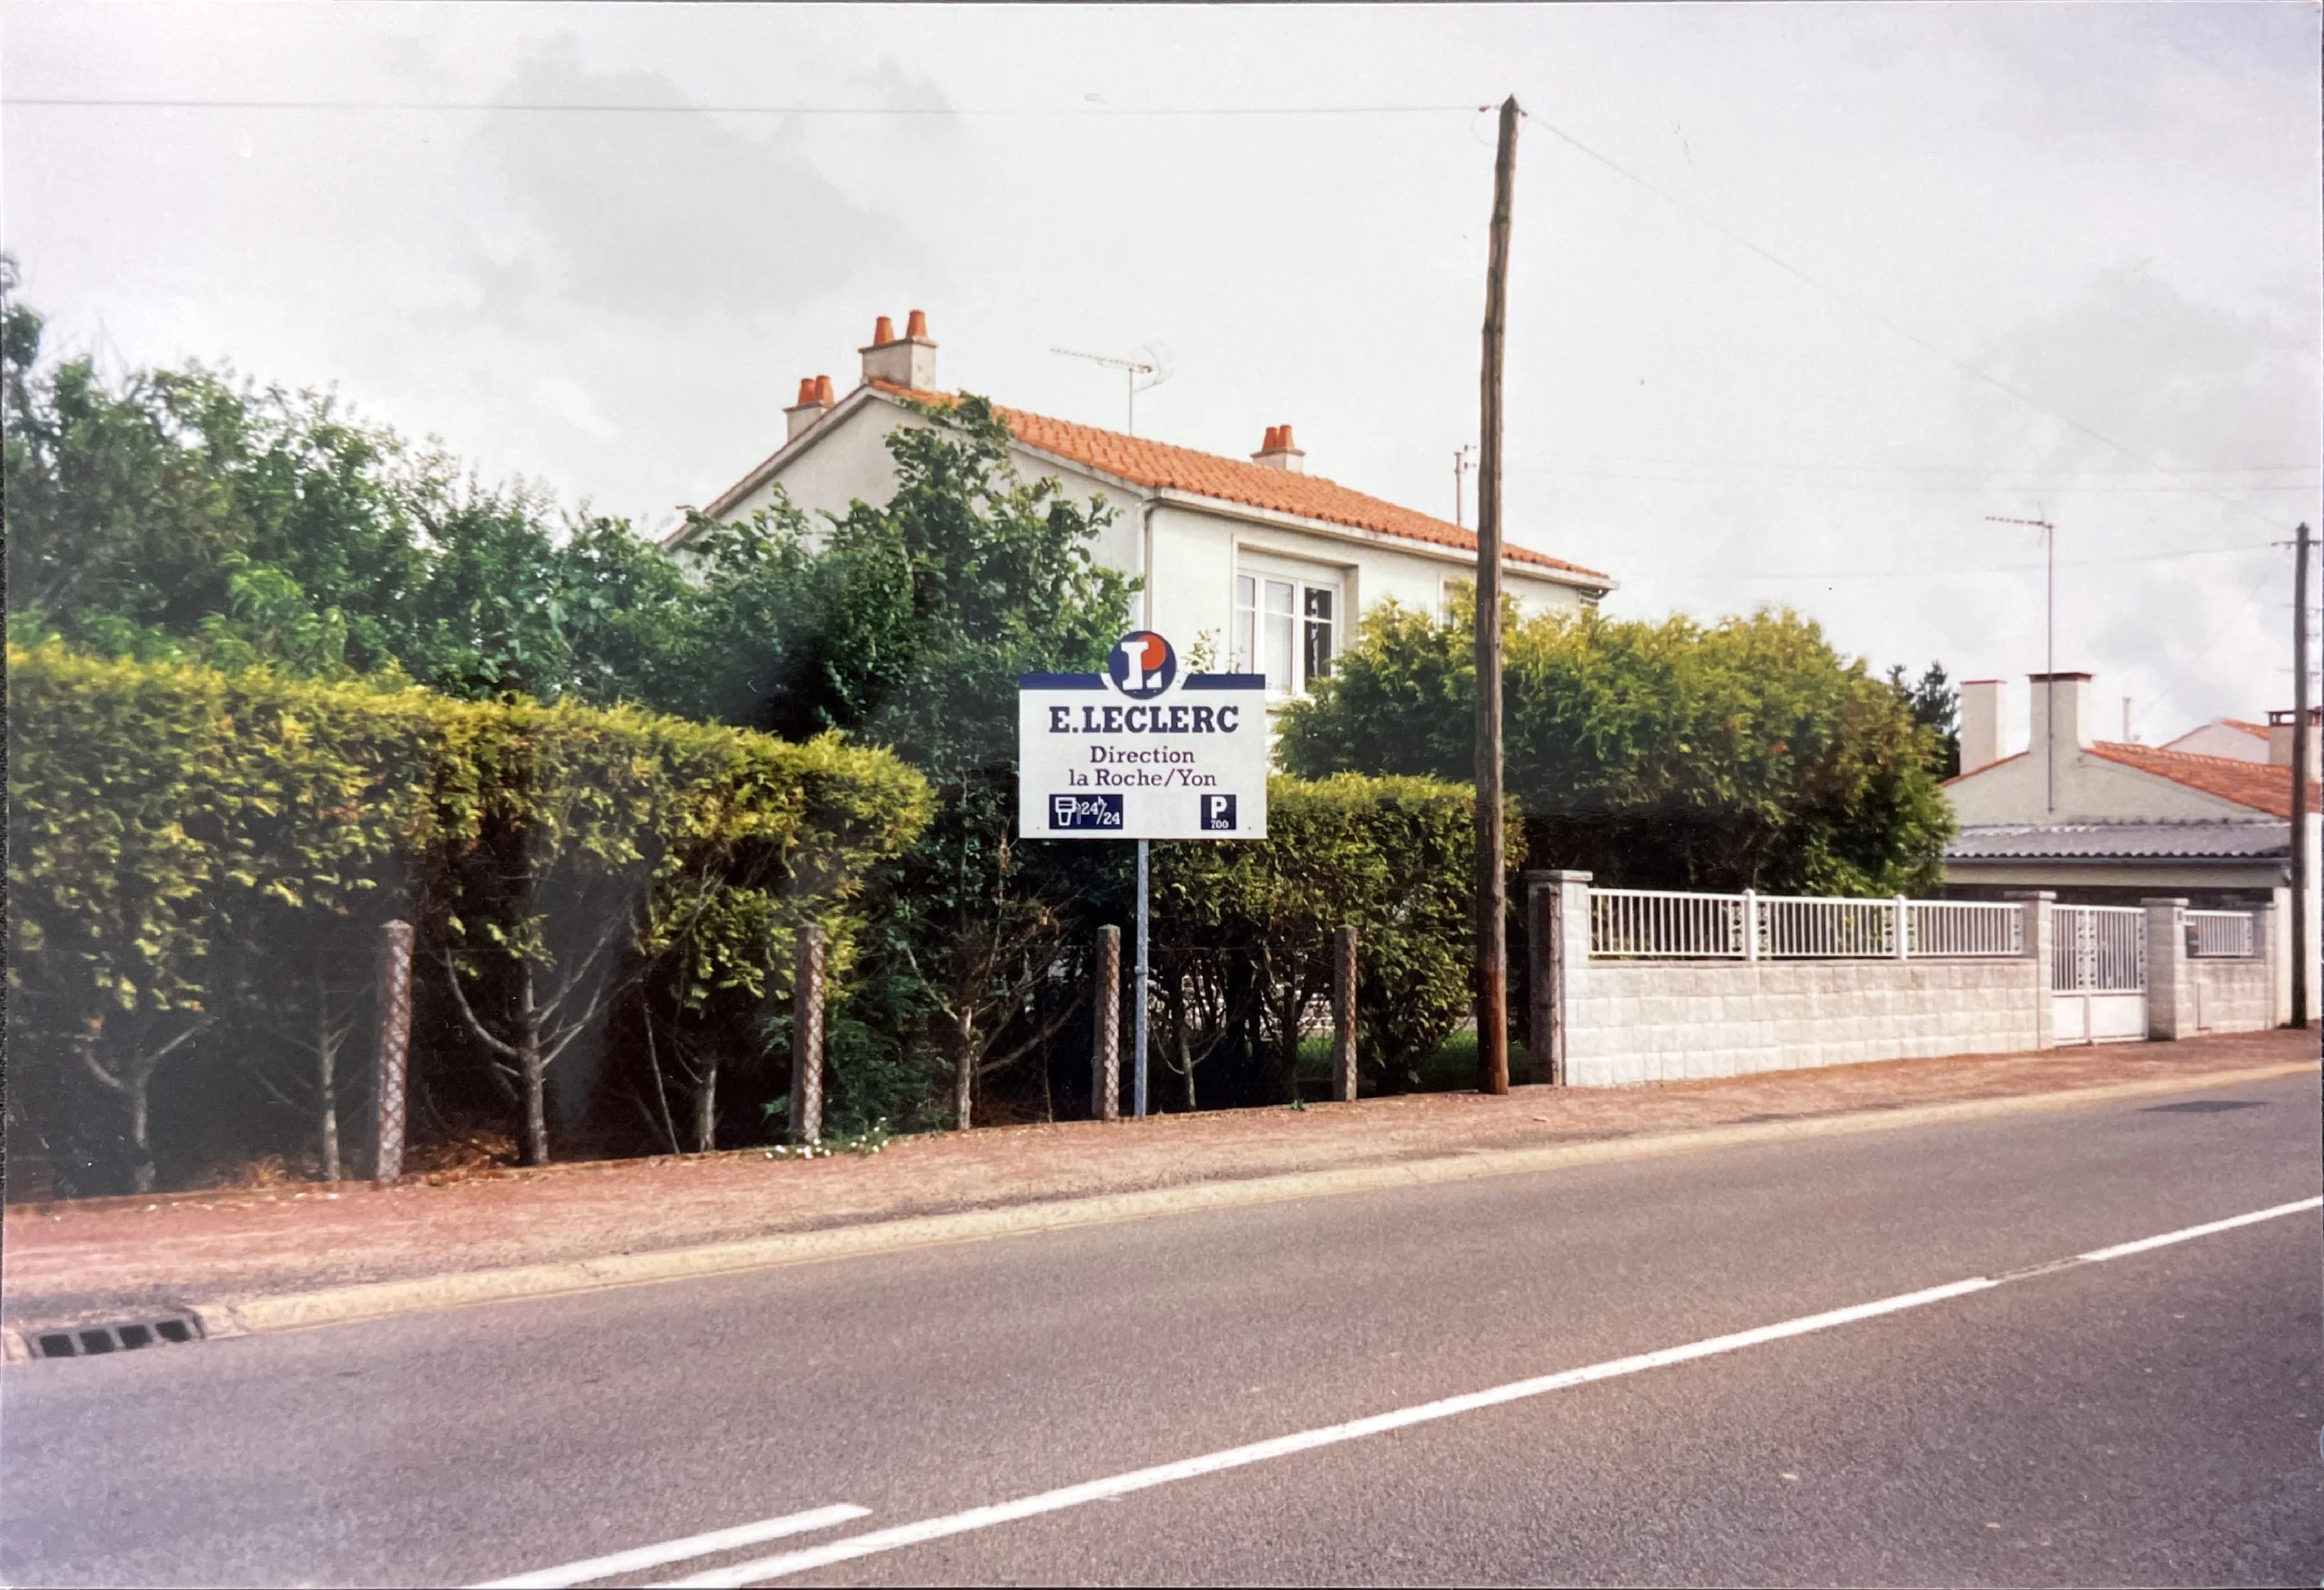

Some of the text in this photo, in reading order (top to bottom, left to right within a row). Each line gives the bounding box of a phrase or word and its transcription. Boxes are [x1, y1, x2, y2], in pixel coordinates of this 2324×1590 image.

[1120, 641, 1162, 690] L
[1049, 706, 1239, 733] E.LECLERC
[1090, 746, 1196, 764] Direction
[1068, 768, 1216, 787] la Roche/Yon
[1210, 796, 1227, 818] P
[1210, 819, 1229, 829] 700
